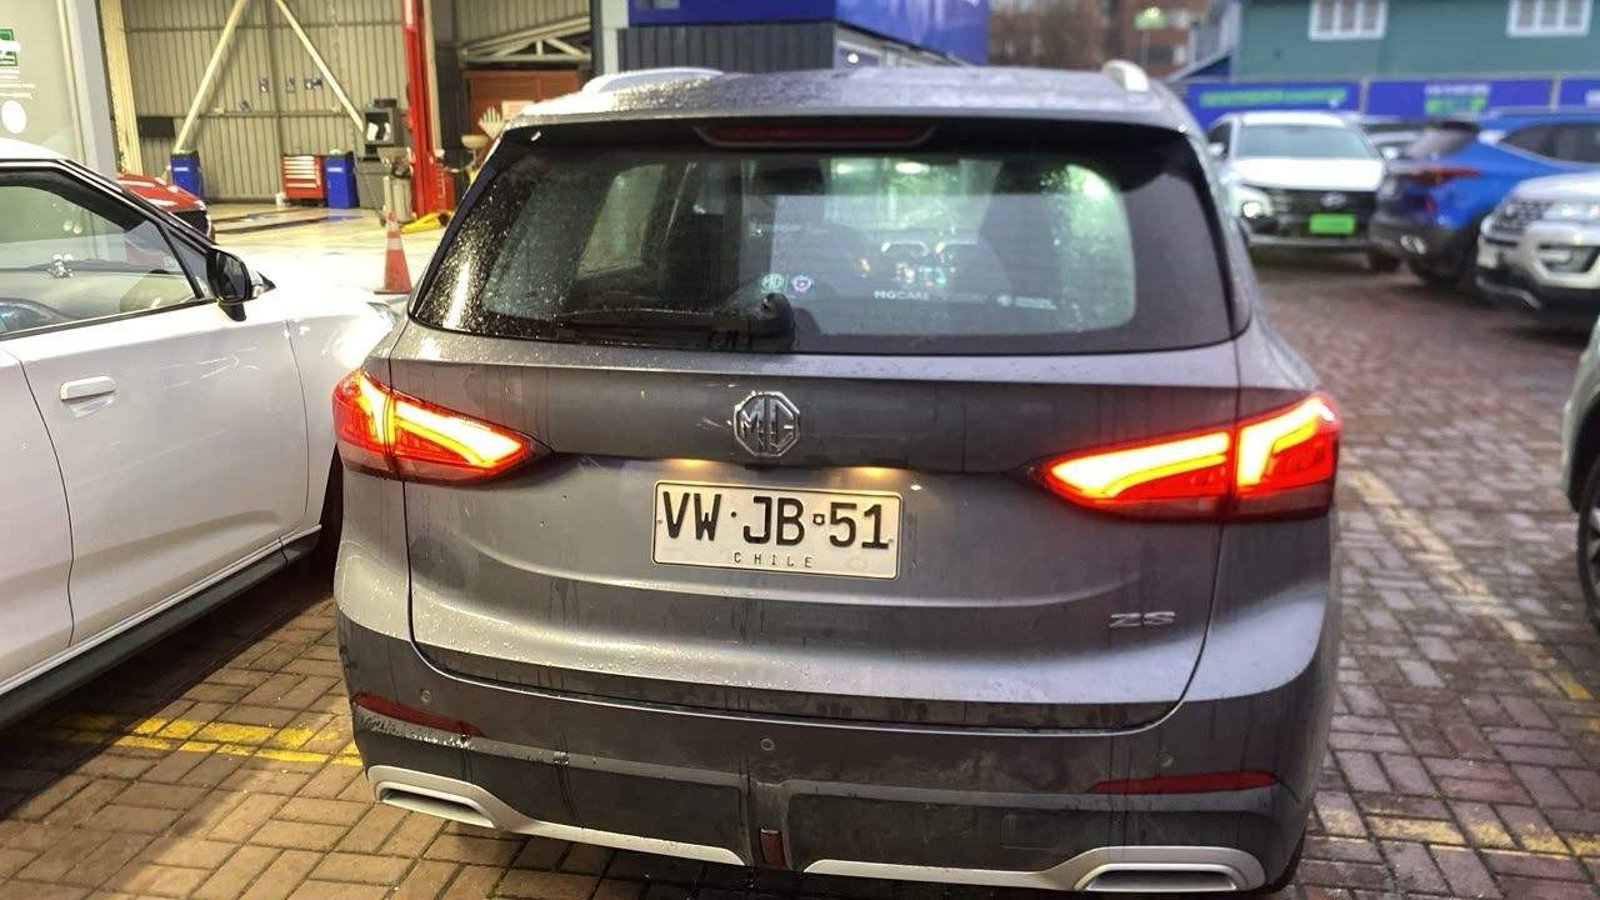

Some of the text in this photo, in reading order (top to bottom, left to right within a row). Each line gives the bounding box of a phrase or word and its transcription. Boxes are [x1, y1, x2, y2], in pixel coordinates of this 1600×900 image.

[738, 395, 797, 453] MG
[733, 551, 814, 569] CHILE
[1109, 611, 1175, 627] ZS
